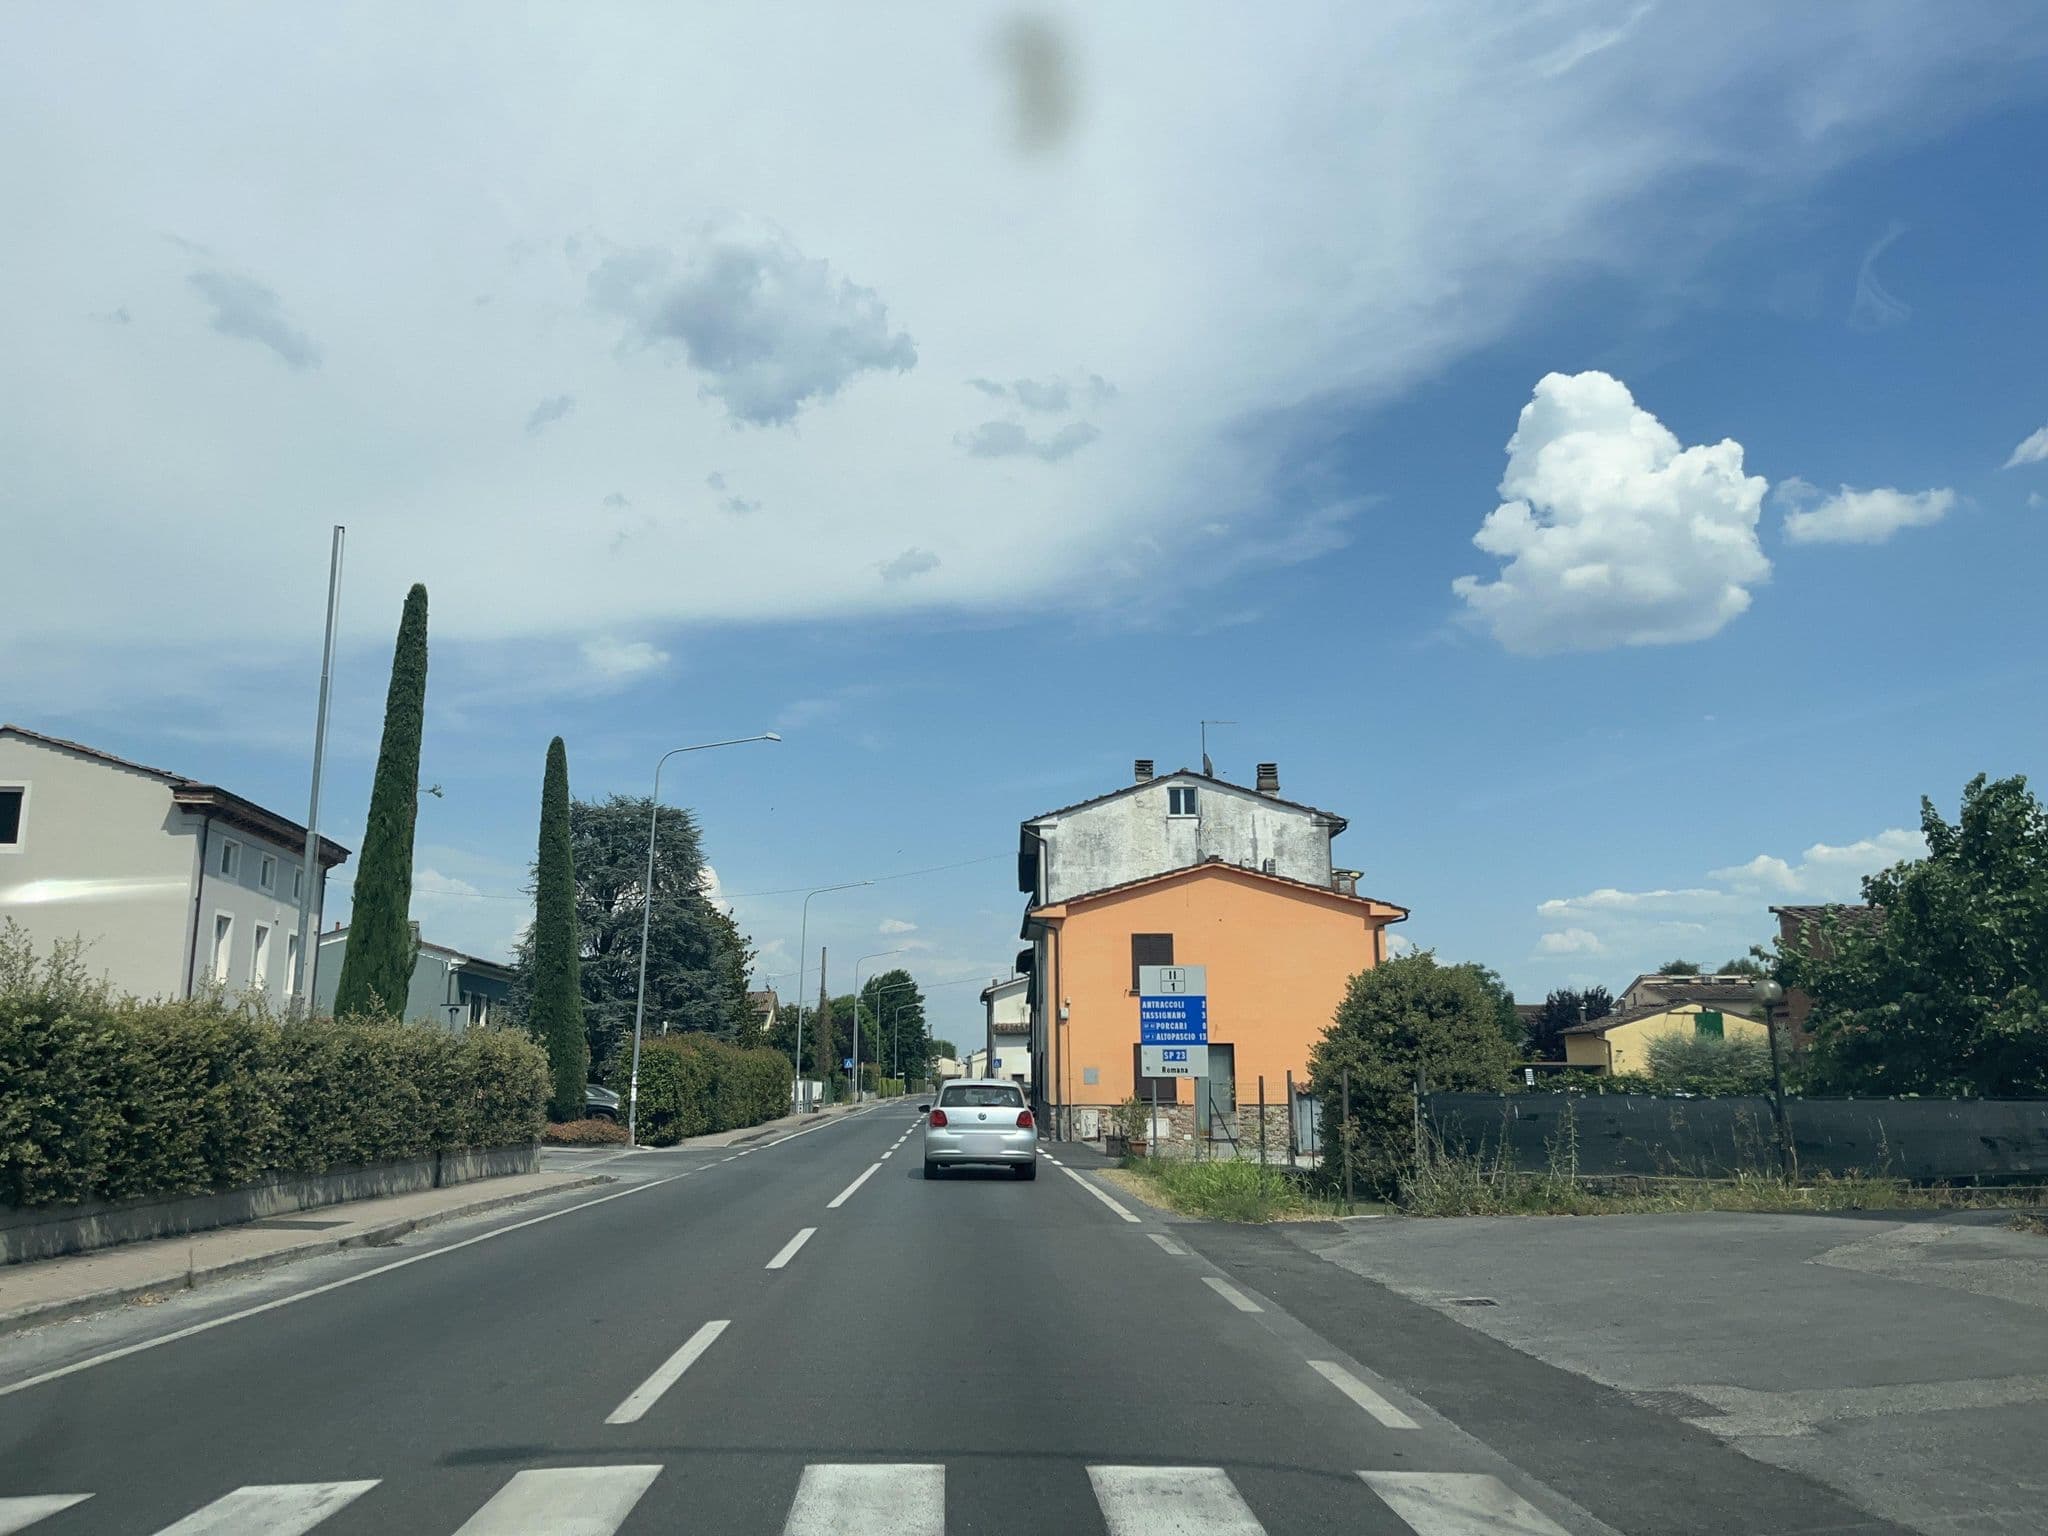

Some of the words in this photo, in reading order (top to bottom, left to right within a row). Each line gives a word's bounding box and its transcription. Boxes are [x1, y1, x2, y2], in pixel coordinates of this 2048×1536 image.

[1171, 983, 1176, 992] 1
[1142, 1001, 1184, 1009] ANTRACCOLI
[1142, 1011, 1186, 1019] TASSIGNANO
[1156, 1022, 1187, 1030] PORCARI
[1156, 1033, 1196, 1041] ALTOPASCIO
[1164, 1051, 1174, 1060] SP
[1176, 1051, 1186, 1060] 23
